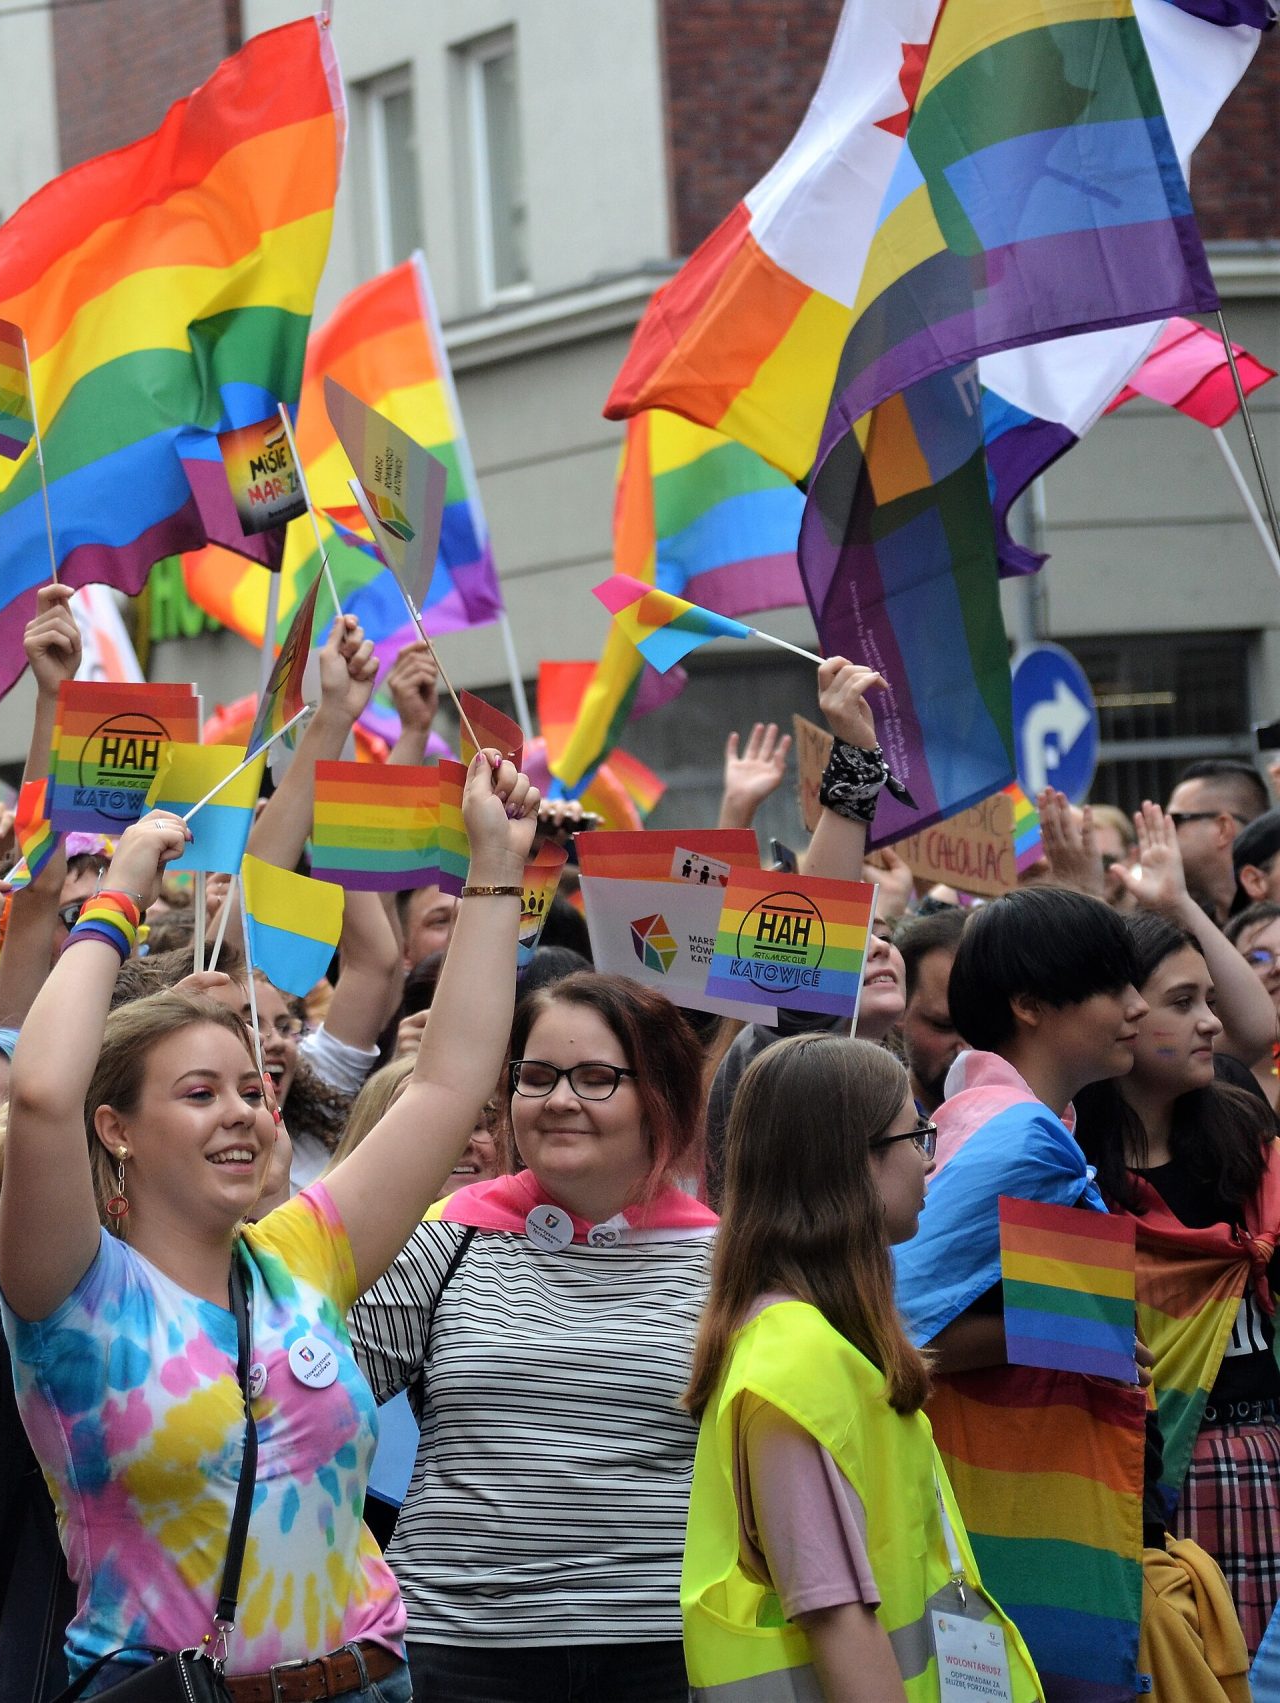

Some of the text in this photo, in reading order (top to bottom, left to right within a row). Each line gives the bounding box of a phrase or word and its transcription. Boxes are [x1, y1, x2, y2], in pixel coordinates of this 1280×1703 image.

[99, 736, 160, 771] HAH
[73, 788, 146, 810] KATOW
[756, 911, 812, 947] HAH
[689, 935, 717, 946] MARS
[690, 944, 714, 955] RÓW
[729, 959, 822, 987] KATOWICE
[945, 1655, 1002, 1677] WOLONTARIUSZ
[950, 1670, 1000, 1689] ODPOWIADAM ZA
[967, 1683, 1008, 1700] PORZĄDKOWĄ
